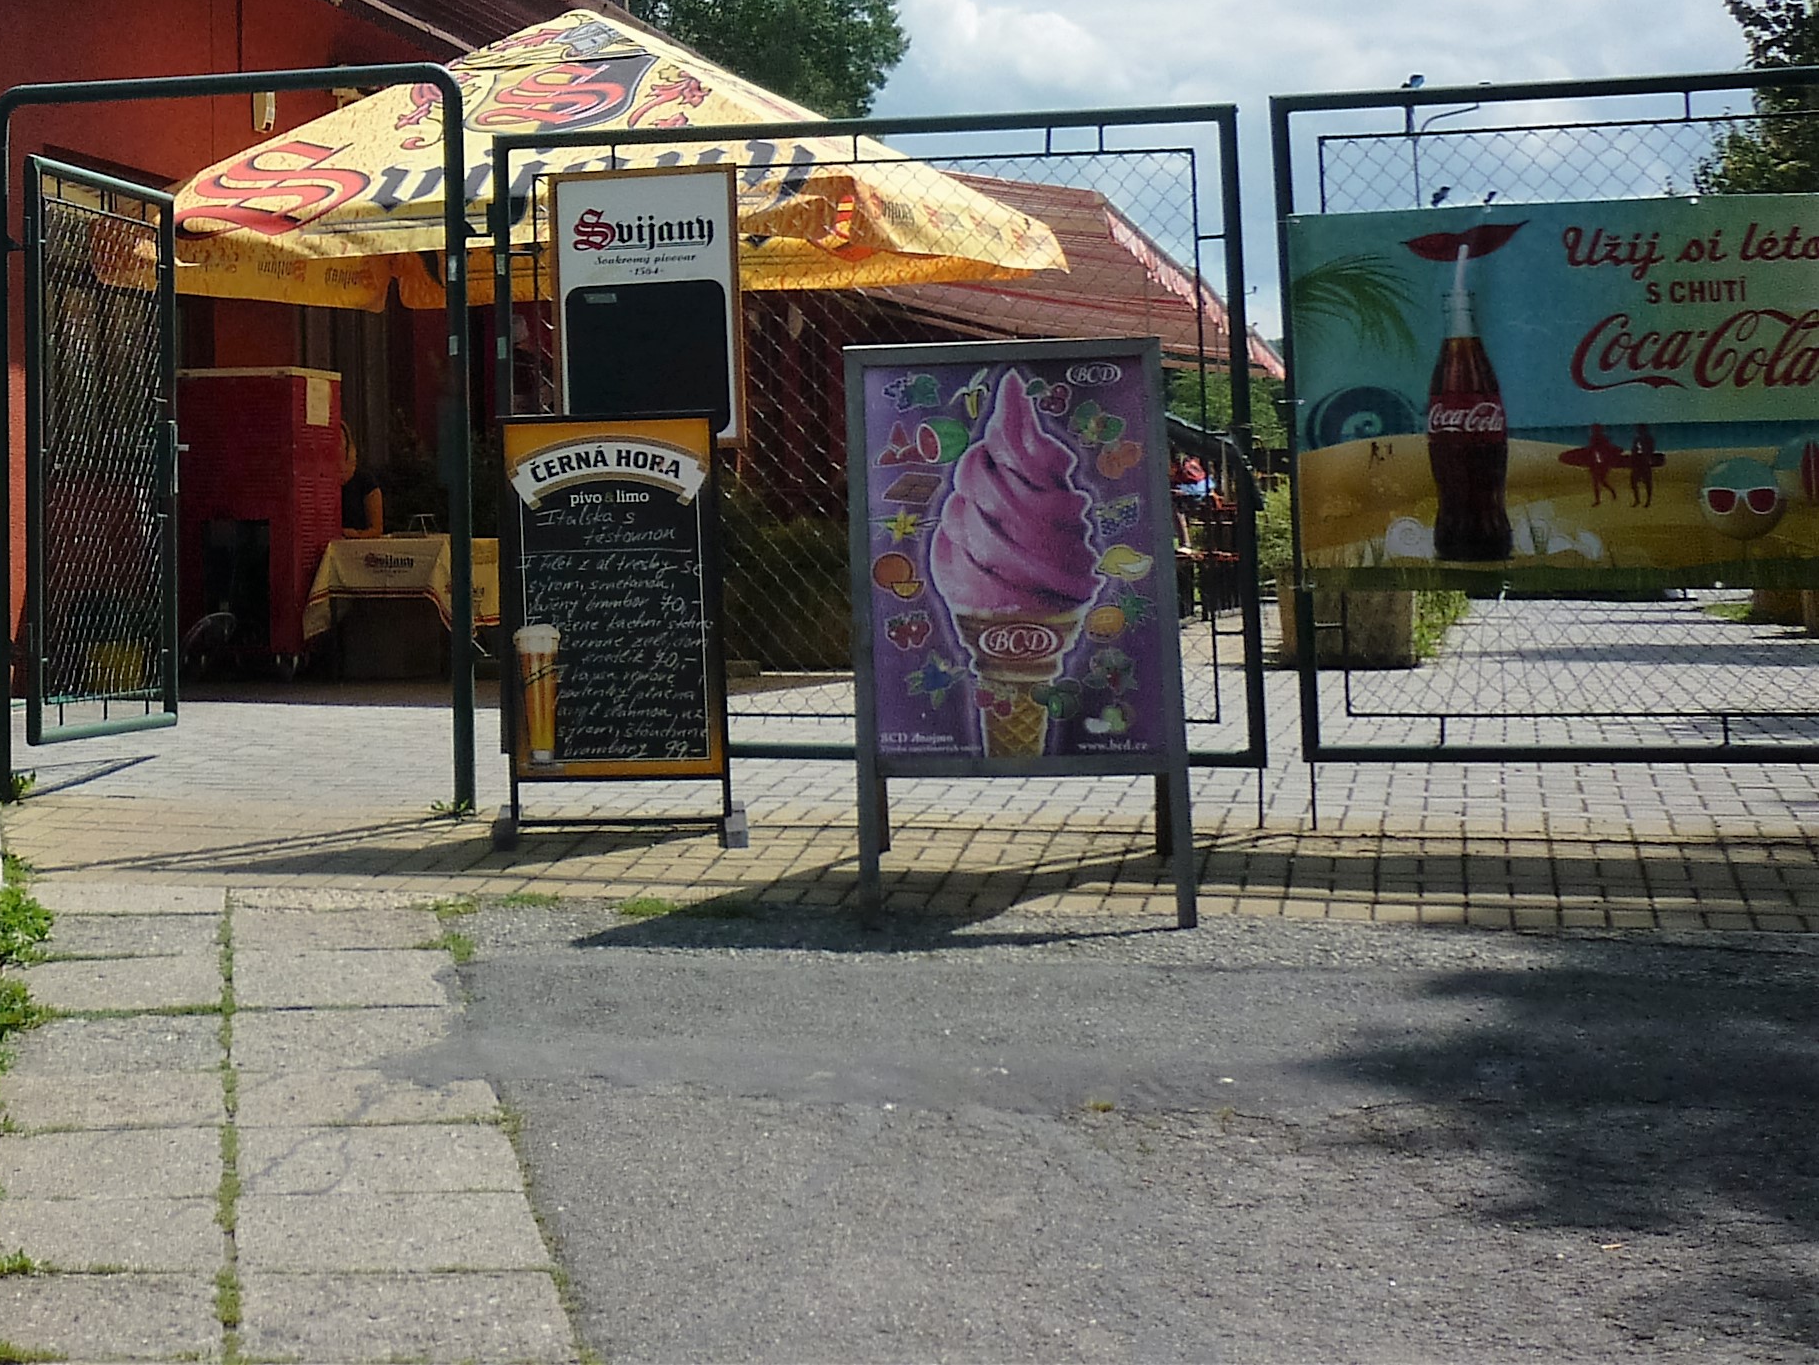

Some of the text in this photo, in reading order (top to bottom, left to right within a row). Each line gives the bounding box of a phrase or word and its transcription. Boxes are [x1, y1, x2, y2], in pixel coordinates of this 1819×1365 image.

[171, 139, 817, 240] Svijy
[573, 208, 714, 251] Svijany
[1564, 223, 1819, 280] Užij si léto
[1646, 276, 1747, 304] S CHUTÍ
[1570, 309, 1819, 391] Coca-Cola
[1071, 365, 1117, 385] BCD
[1428, 402, 1504, 434] Coca-Cola
[530, 445, 681, 483] ČERNÁ HORA
[570, 491, 602, 507] pivo
[616, 489, 650, 504] limo
[988, 629, 1049, 654] BCD
